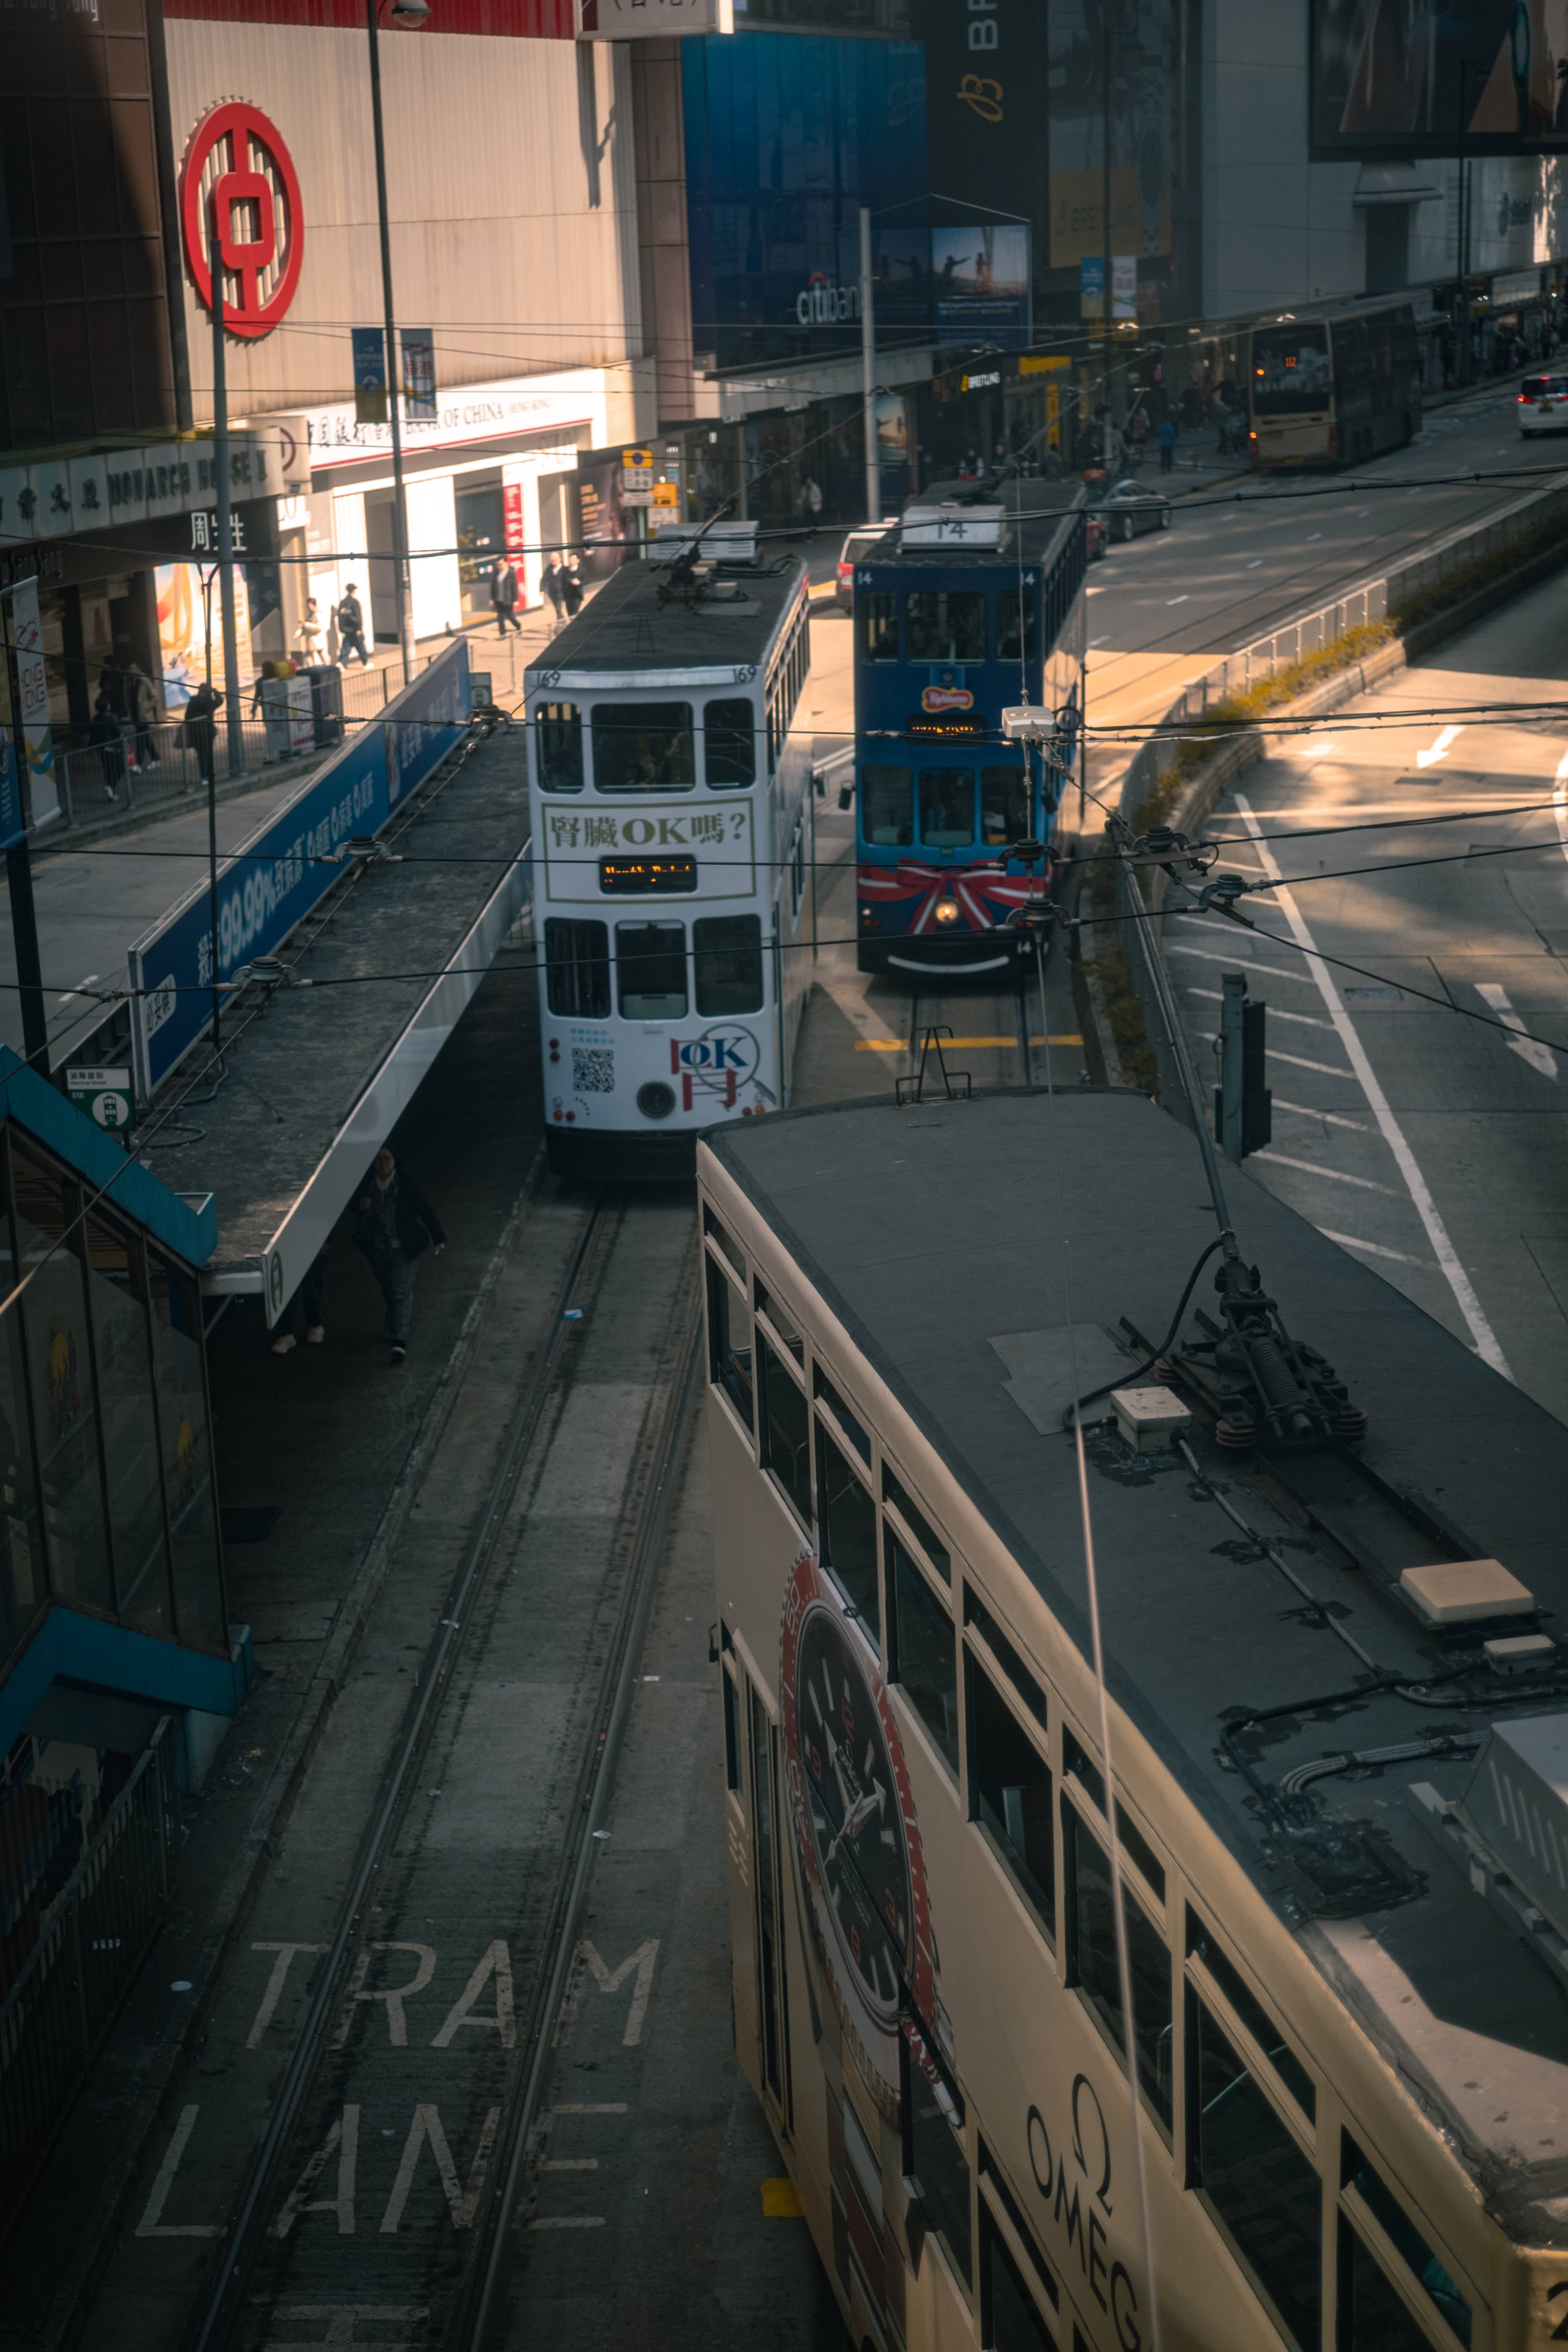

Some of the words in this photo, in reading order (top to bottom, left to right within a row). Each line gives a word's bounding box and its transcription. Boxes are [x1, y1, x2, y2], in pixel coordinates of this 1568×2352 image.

[1285, 356, 1297, 368] 112
[444, 408, 460, 428] OF
[463, 402, 504, 425] CHINA
[107, 461, 191, 506] MONARCH
[197, 452, 251, 491] HOSE
[858, 571, 873, 585] 14
[537, 672, 561, 688] 169
[733, 666, 756, 683] 169
[1017, 941, 1032, 955] 14
[245, 1939, 662, 2050] TRAM
[134, 2103, 628, 2240] LANE
[1027, 2104, 1152, 2352] OMEG
